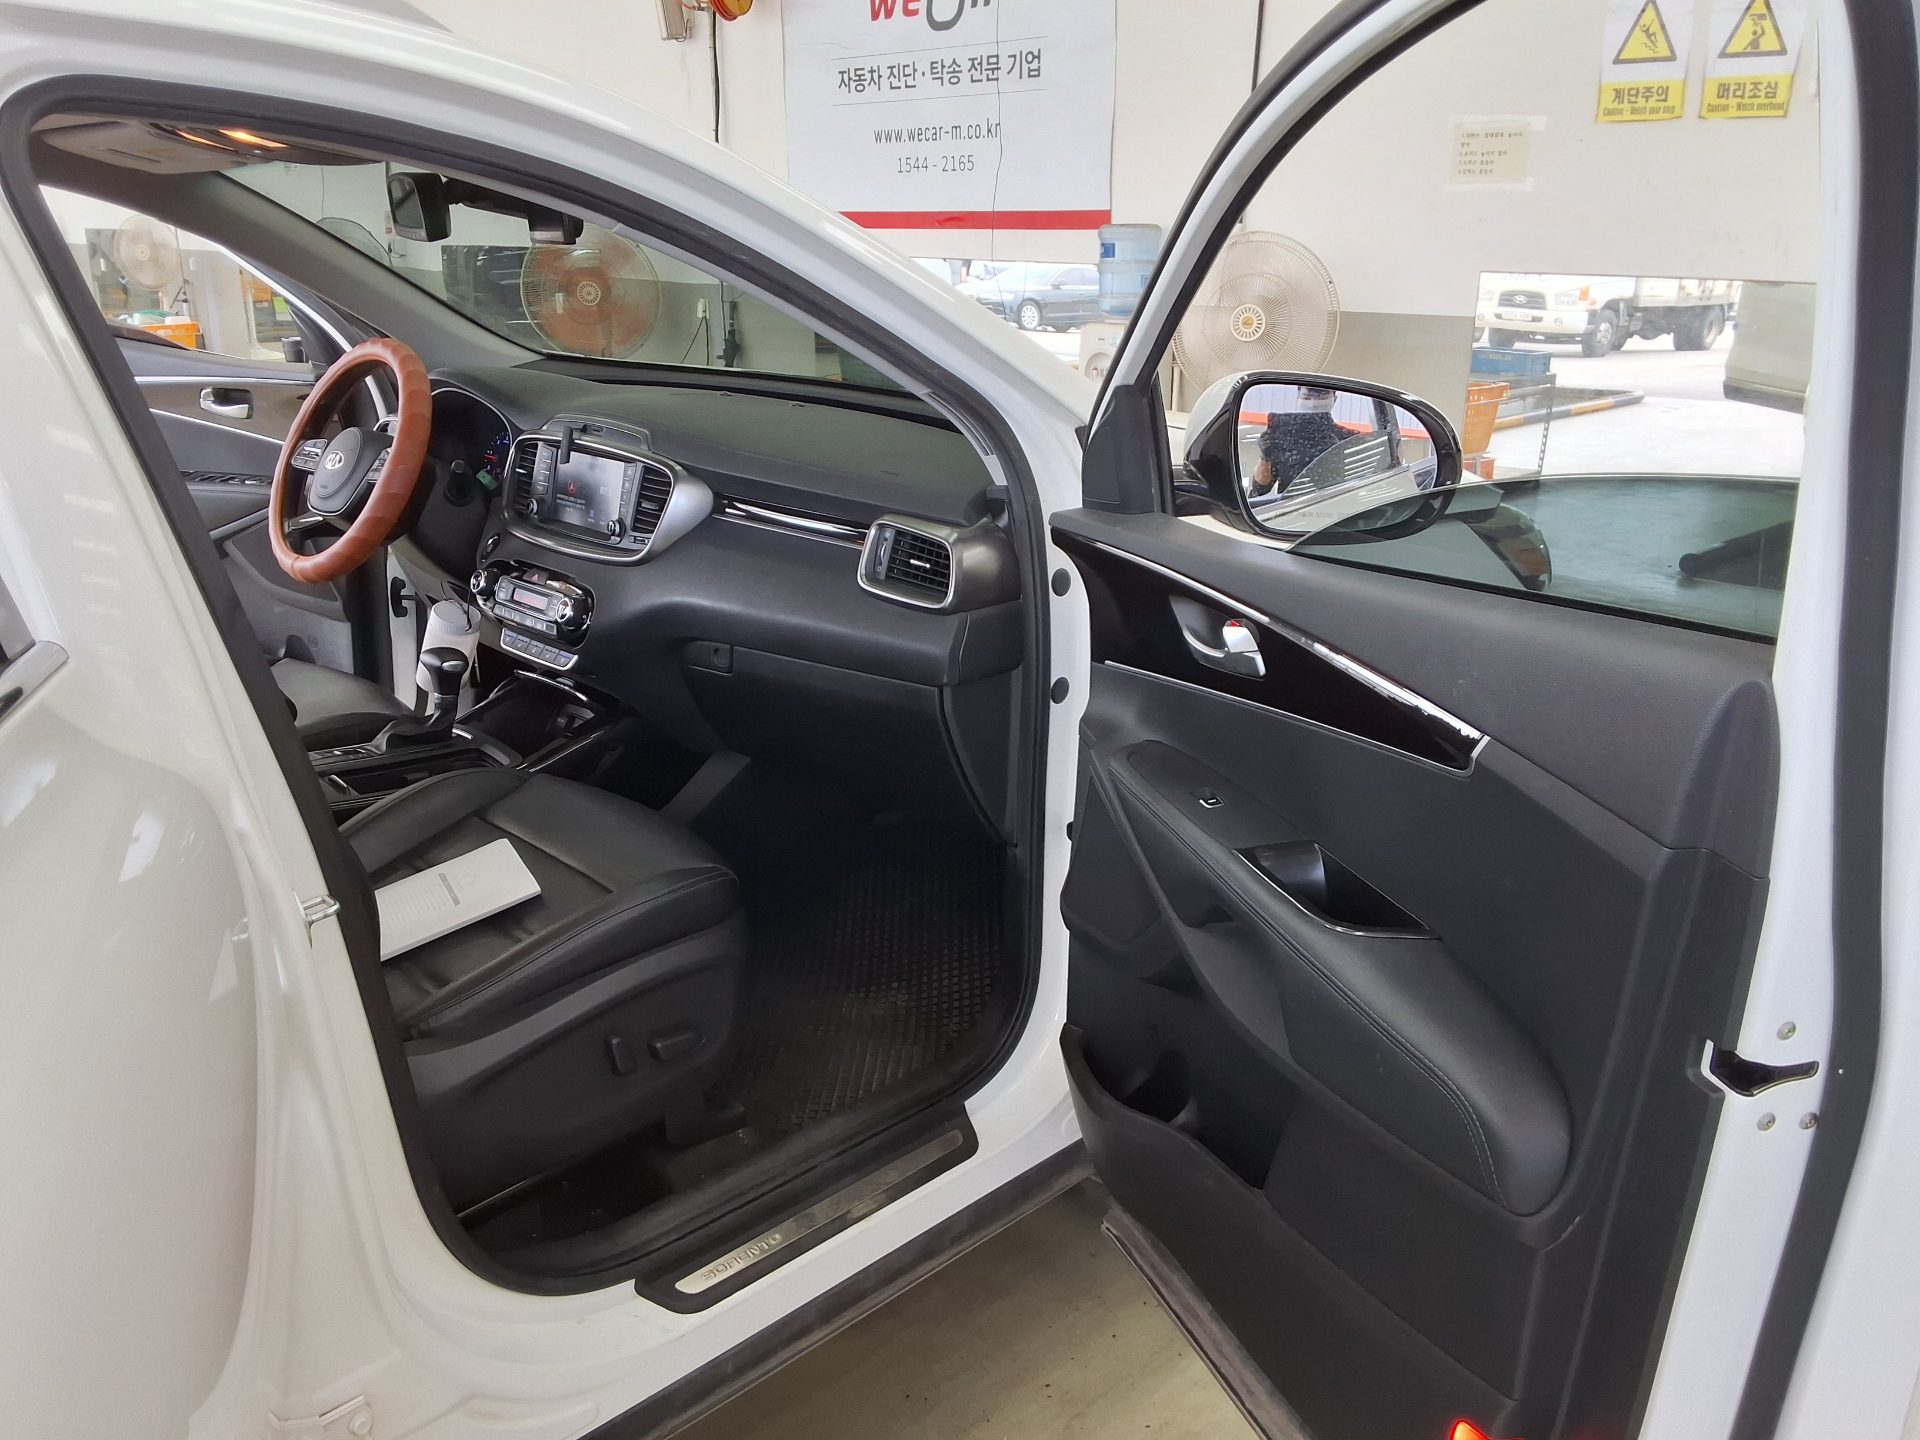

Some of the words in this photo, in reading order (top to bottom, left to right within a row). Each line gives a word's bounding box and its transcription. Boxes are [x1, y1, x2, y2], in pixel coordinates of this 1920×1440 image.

[838, 65, 883, 93] 자동차
[967, 54, 1002, 83] 전문
[1006, 48, 1042, 80] 기업
[1611, 85, 1670, 105] 계단주의
[1716, 81, 1779, 100] 머리조심
[873, 118, 1001, 145] www.wecar-m.co.kr
